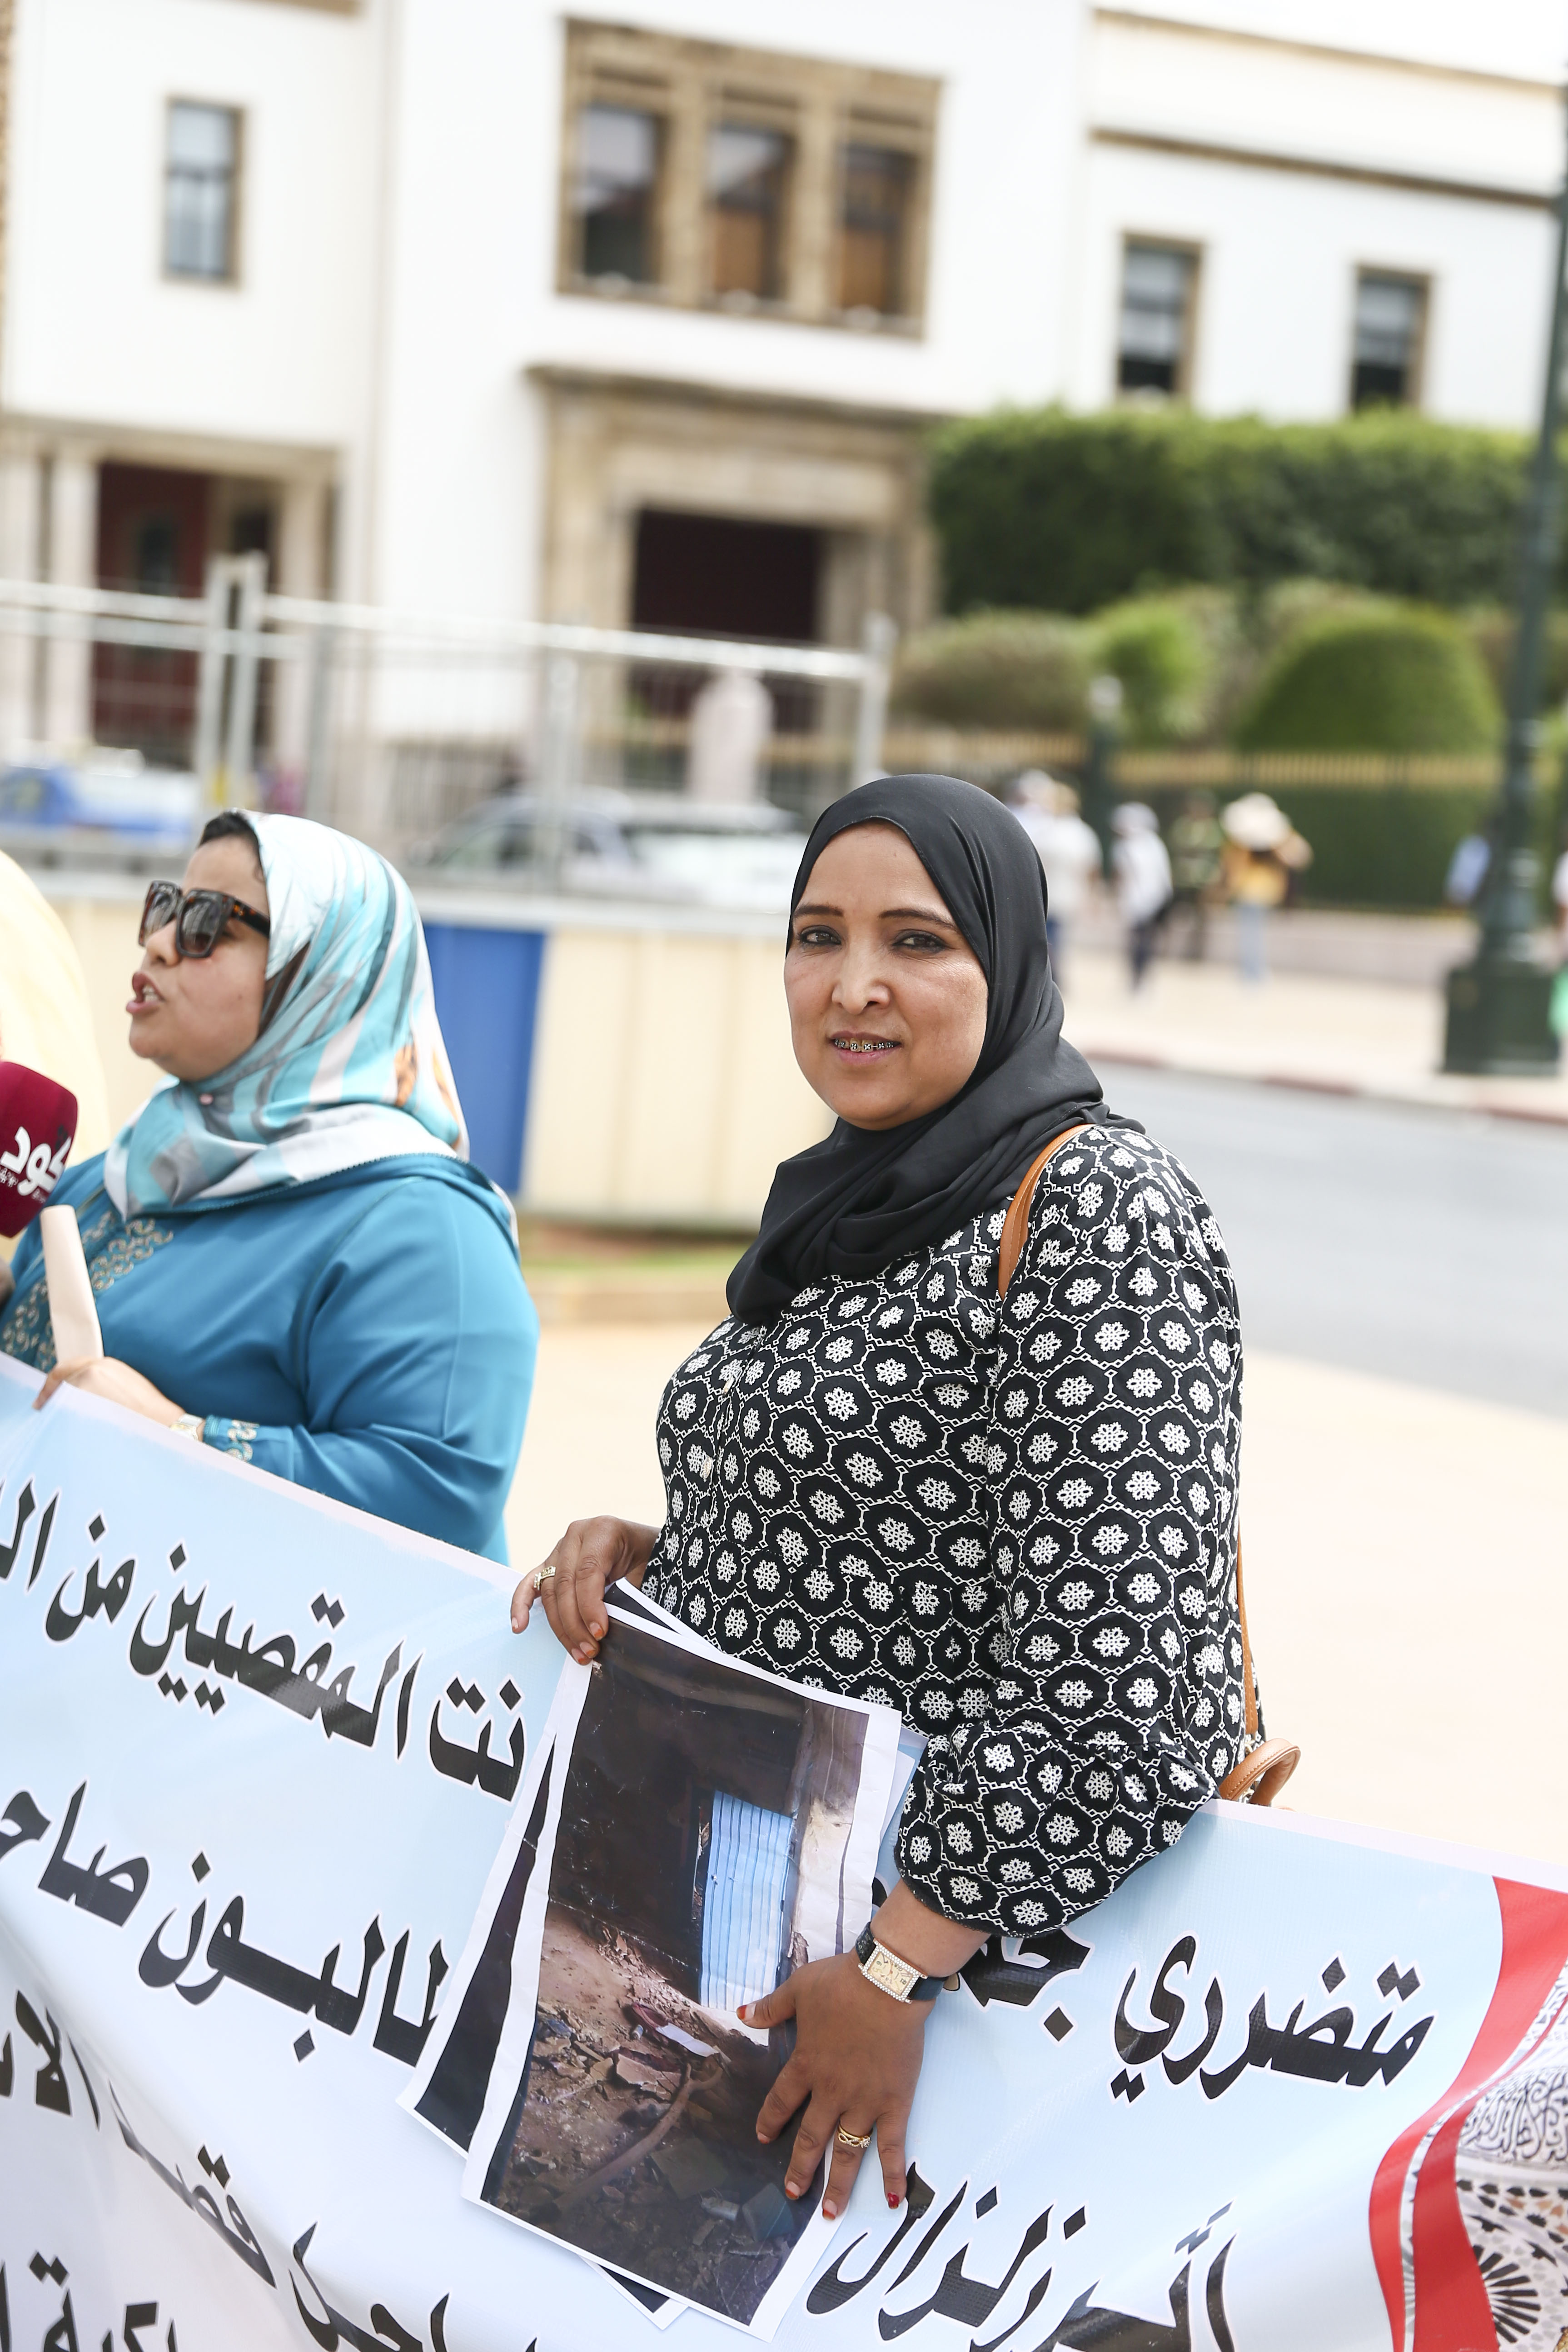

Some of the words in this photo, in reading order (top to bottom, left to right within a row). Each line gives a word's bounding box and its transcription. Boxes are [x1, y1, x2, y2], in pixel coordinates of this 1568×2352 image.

[46, 1515, 136, 1641] من
[130, 1545, 423, 1759] المقصيين
[1114, 1936, 1434, 2103] متضرري
[806, 2161, 1087, 2352] زلزال
